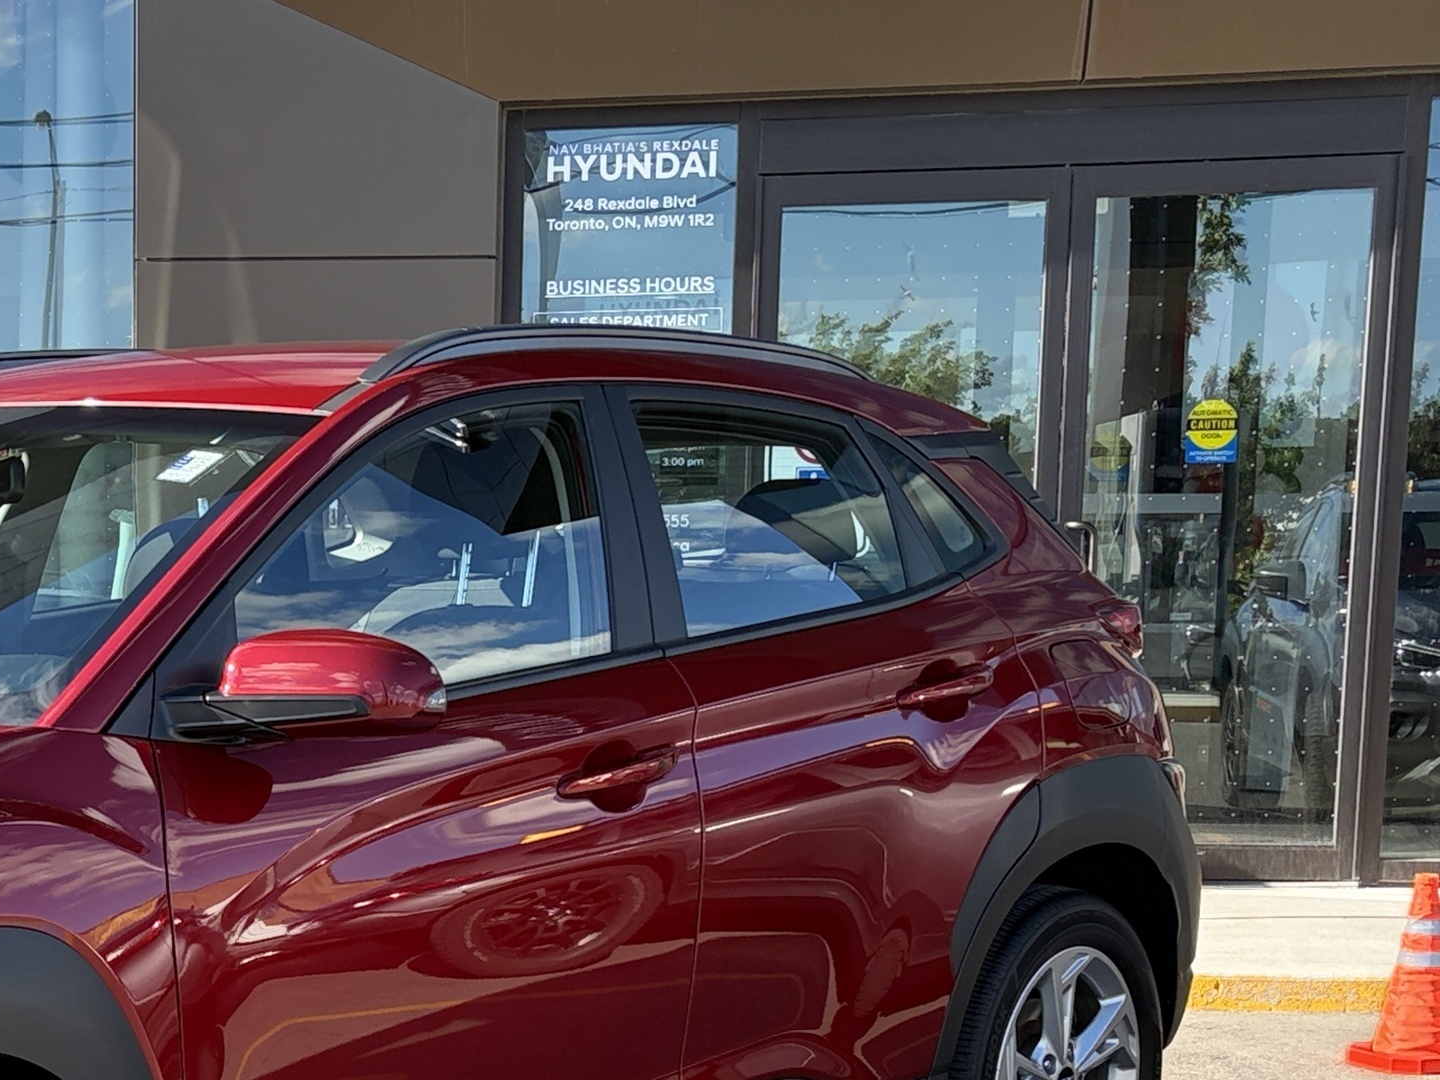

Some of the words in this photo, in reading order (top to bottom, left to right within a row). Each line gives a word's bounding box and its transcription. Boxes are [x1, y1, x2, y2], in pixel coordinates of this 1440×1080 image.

[549, 144, 579, 156] NAV
[583, 141, 648, 154] BHATIA'S
[653, 139, 719, 152] REXDALE
[546, 150, 718, 183] HYUNDAI
[564, 198, 594, 212] 248
[597, 196, 660, 211] Rexdale
[663, 194, 697, 209] Blvd
[546, 218, 609, 232] Toronto,
[612, 216, 641, 230] ON,
[644, 215, 685, 228] M9W
[689, 213, 714, 227] 1R2
[546, 278, 641, 296] BUSINESS
[646, 276, 715, 293] HOURS
[601, 313, 710, 328] DEPARTMENT
[1190, 419, 1236, 430] CAUTION
[687, 457, 705, 467] pm
